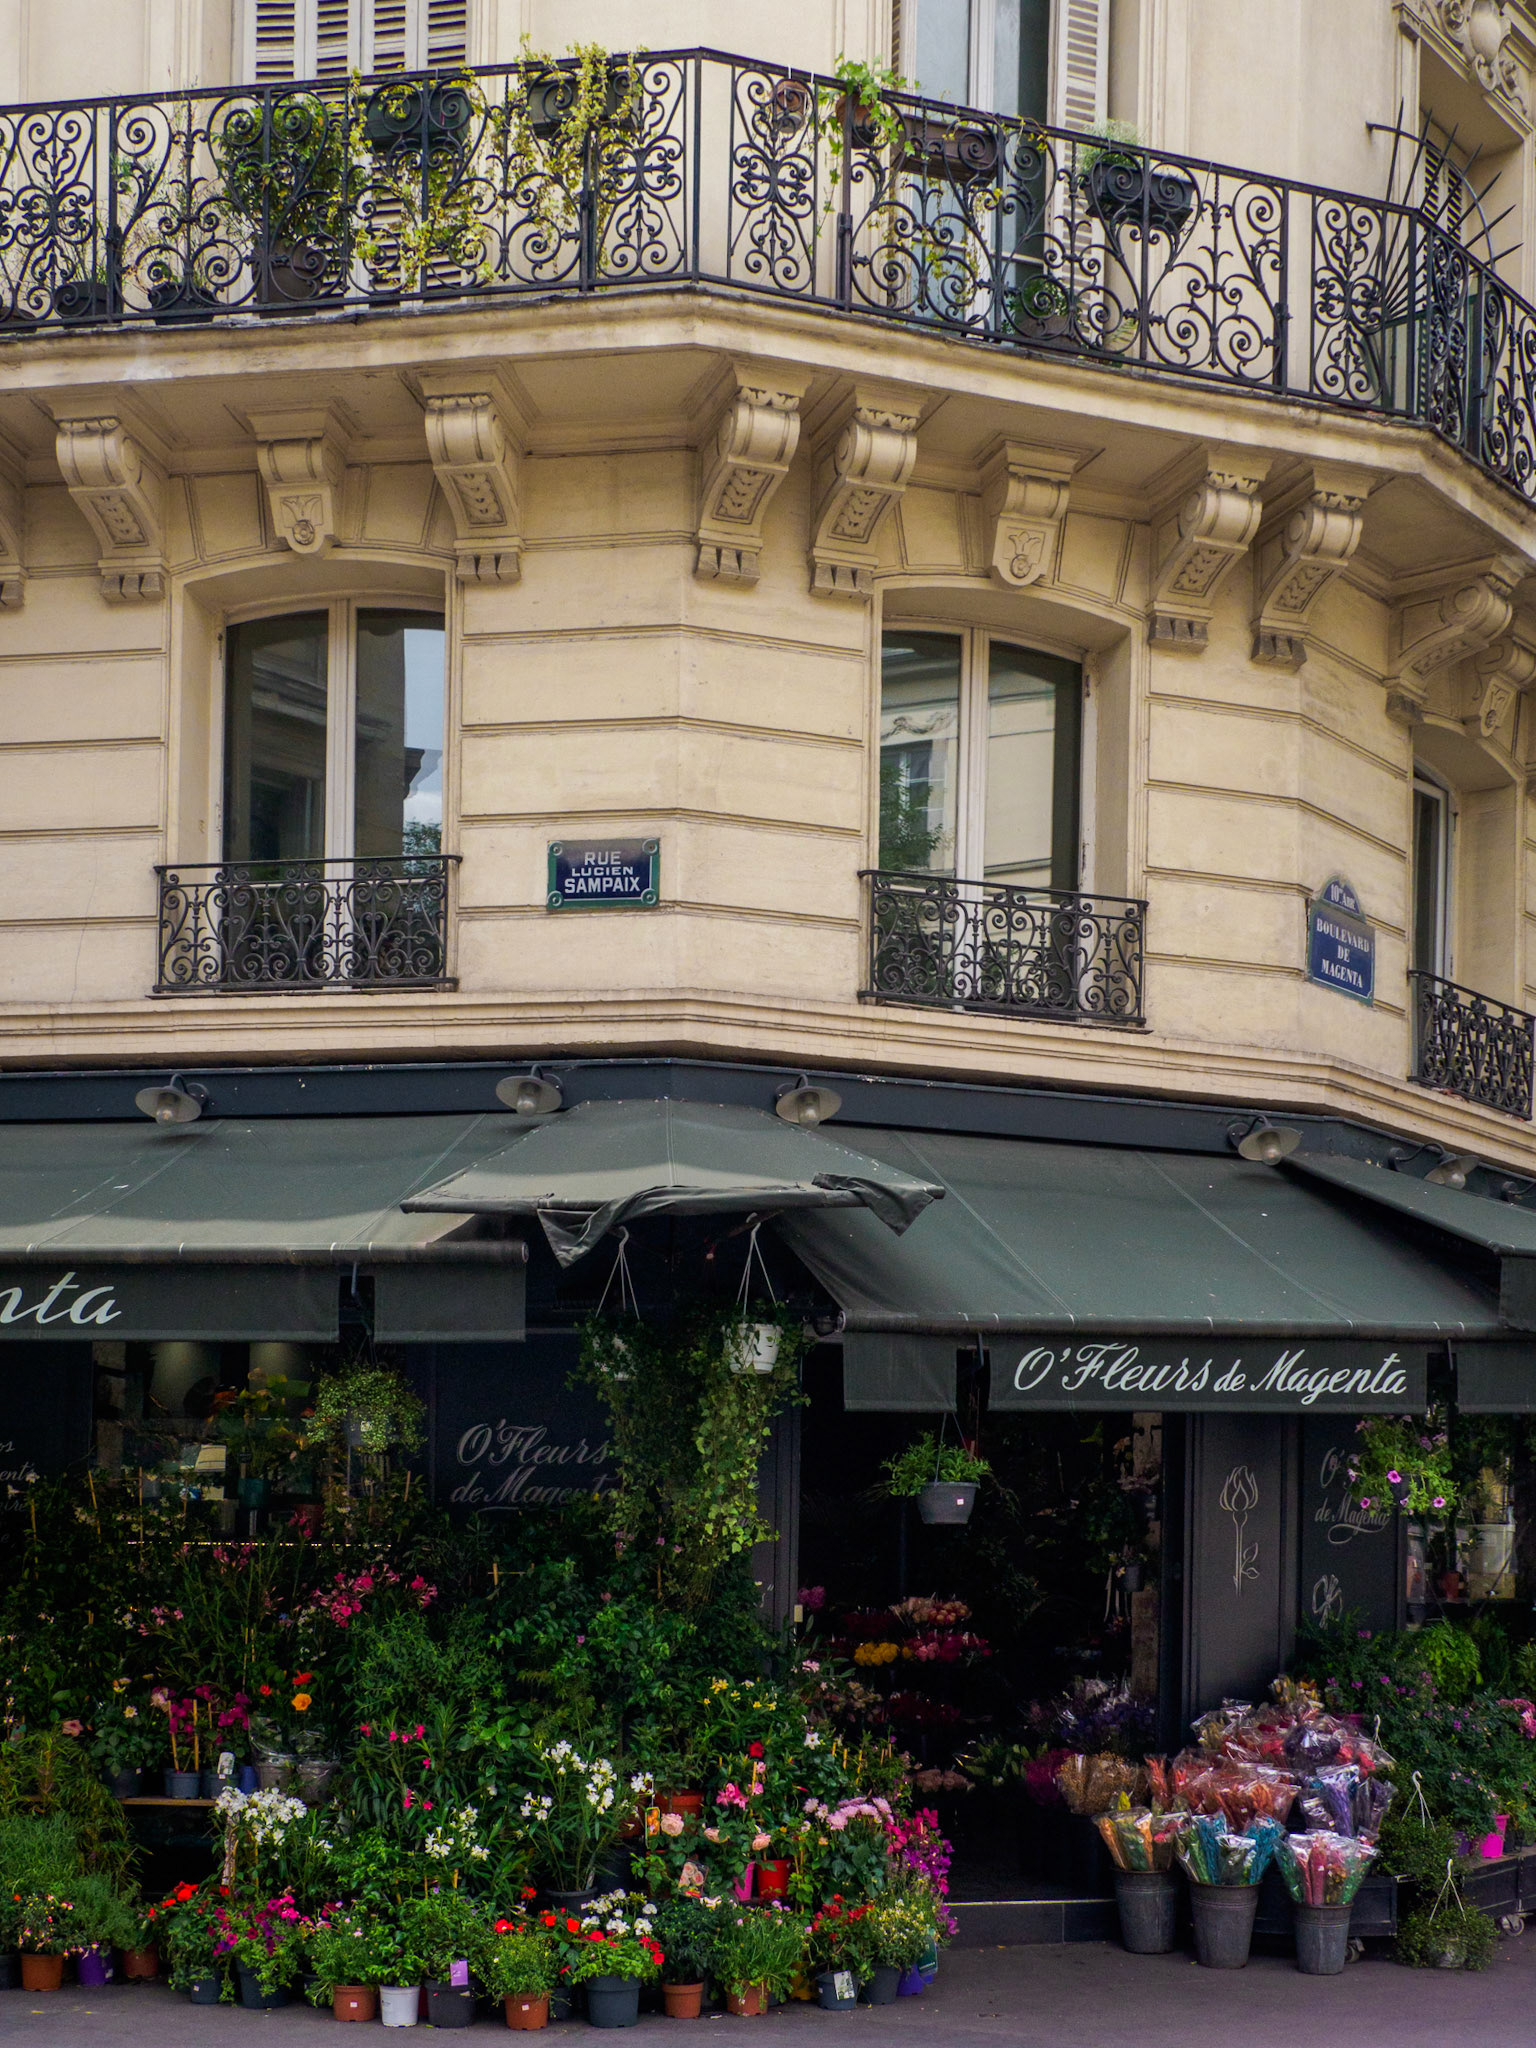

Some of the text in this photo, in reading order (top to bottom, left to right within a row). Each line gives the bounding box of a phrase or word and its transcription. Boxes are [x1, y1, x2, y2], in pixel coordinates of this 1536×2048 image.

[571, 866, 634, 877] LUCIEN
[584, 851, 622, 866] RUE
[564, 877, 641, 894] SAMPAIX
[1316, 917, 1370, 953] BOULEVARD
[1337, 945, 1351, 963] DE
[1320, 958, 1363, 989] MAGENTA
[1014, 1343, 1407, 1405] O'Fleurs de Magenta
[456, 1418, 610, 1466] O'Fleurs
[450, 1471, 484, 1503] de
[1314, 1497, 1332, 1522] de
